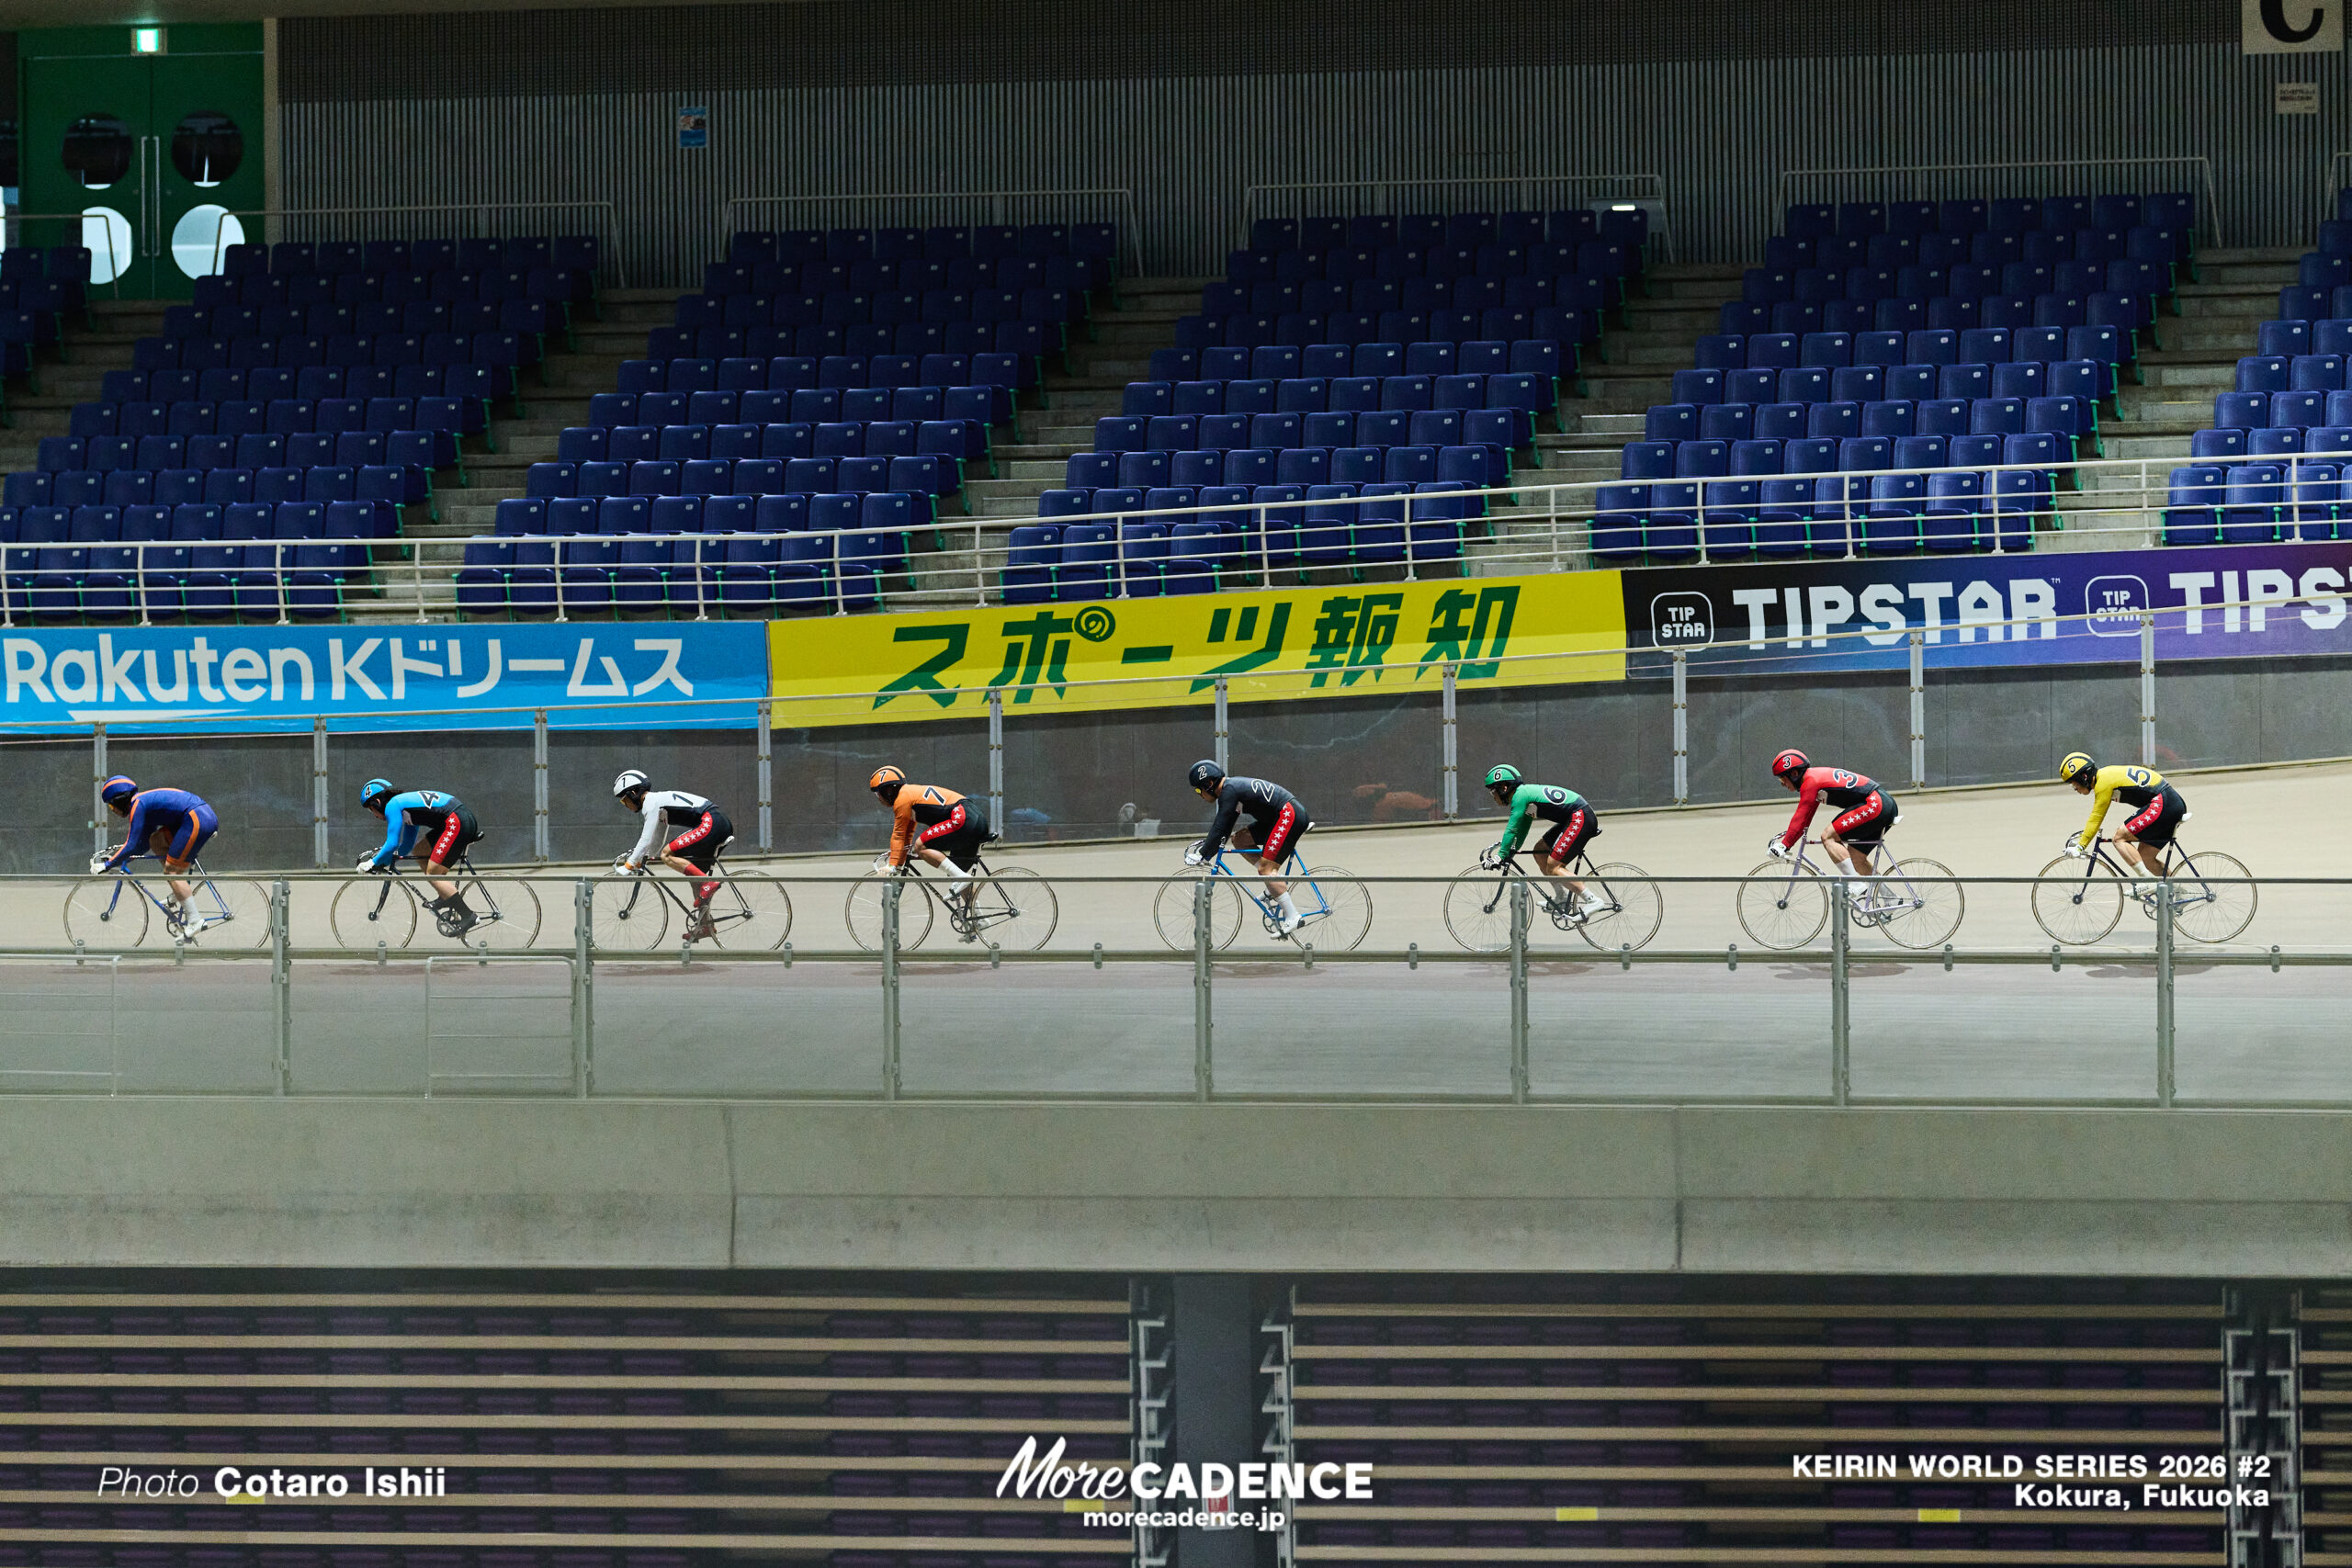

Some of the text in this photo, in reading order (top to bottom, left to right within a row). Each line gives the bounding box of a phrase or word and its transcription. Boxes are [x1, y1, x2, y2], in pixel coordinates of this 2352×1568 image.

[2103, 591, 2131, 606] TIP
[2169, 567, 2352, 634] TIPS
[1668, 607, 1695, 622] TIP
[1661, 622, 1705, 638] STAR
[3, 633, 693, 704] Rakuten Kドリームス
[1782, 756, 1792, 769] 3
[2068, 761, 2076, 773] 5
[879, 771, 887, 783] 7
[1197, 766, 1207, 780] 2
[1494, 770, 1502, 781] 6
[1833, 769, 1858, 789] 3
[2127, 767, 2151, 787] 5
[365, 785, 372, 797] 4
[922, 786, 945, 807] 7
[1251, 779, 1275, 803] 2
[1544, 786, 1566, 806] 6
[418, 790, 441, 809] 4
[673, 793, 694, 807] 1
